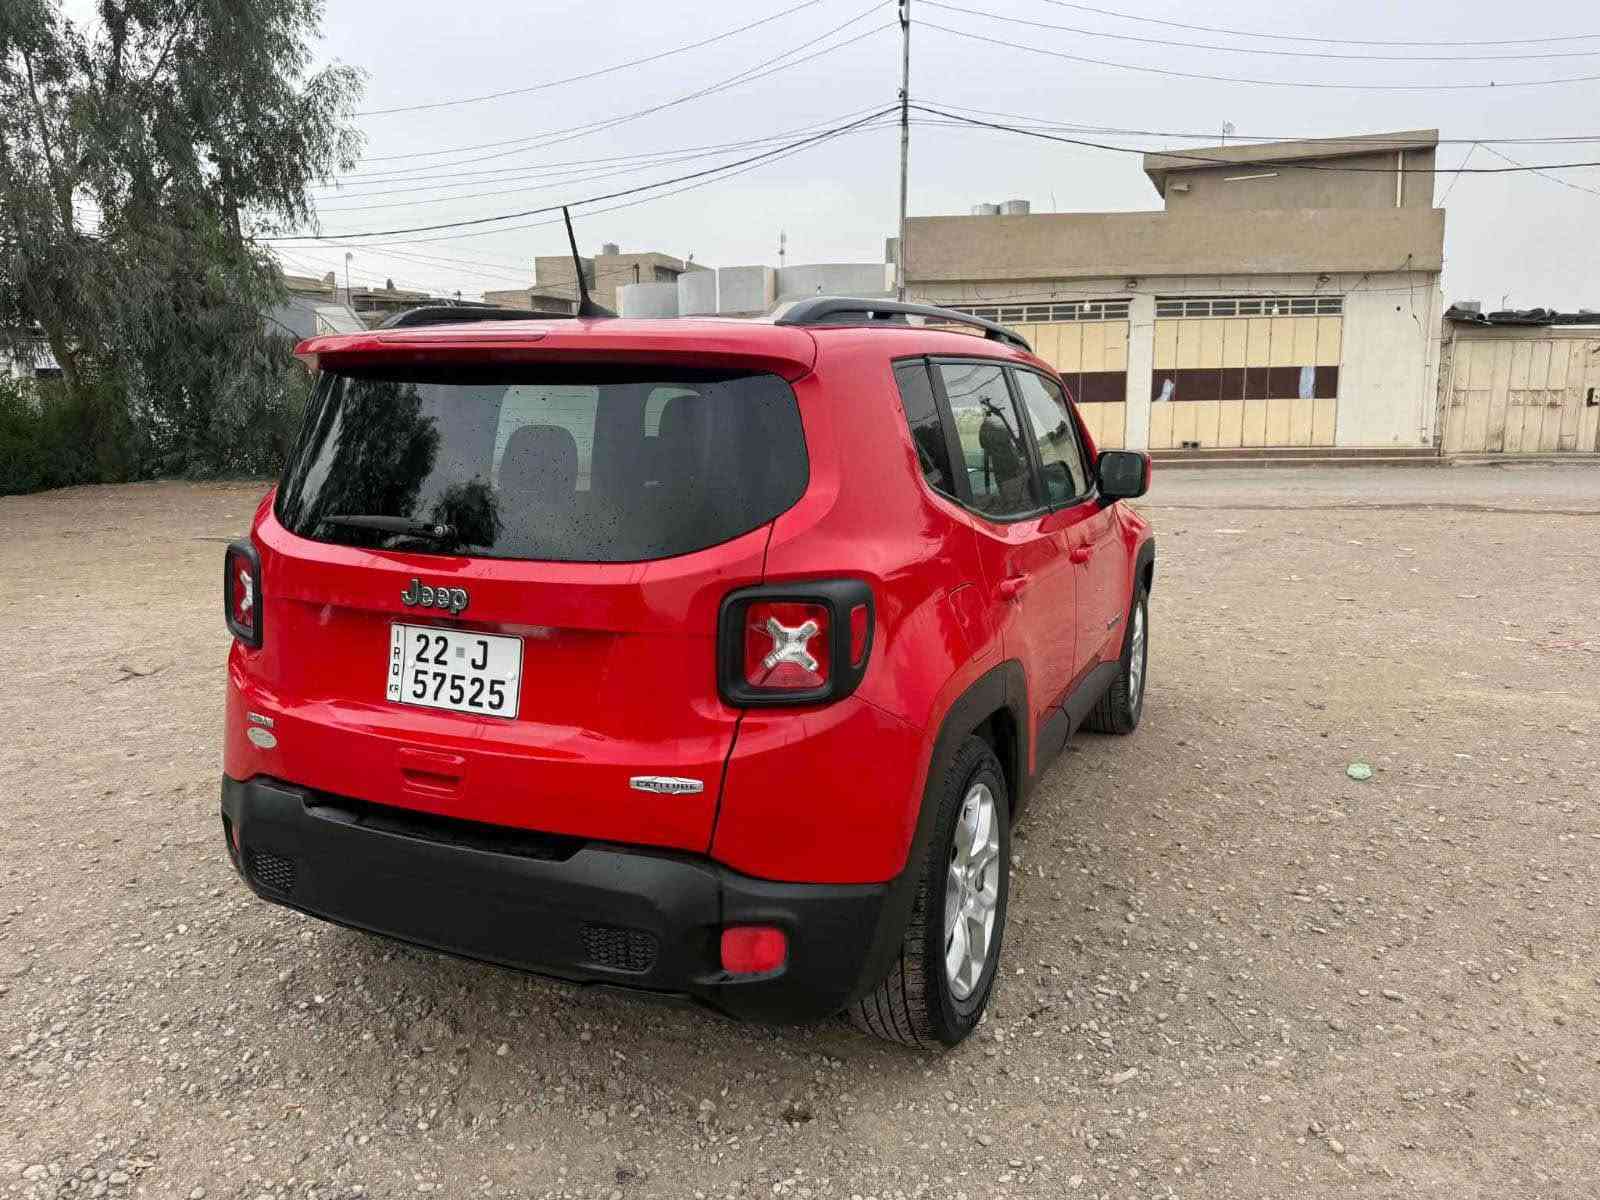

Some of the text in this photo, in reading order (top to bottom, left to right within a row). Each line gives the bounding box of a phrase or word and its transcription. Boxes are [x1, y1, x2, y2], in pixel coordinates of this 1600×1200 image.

[401, 577, 468, 615] Jeep
[415, 633, 489, 671] 22 J
[412, 669, 506, 710] 57525
